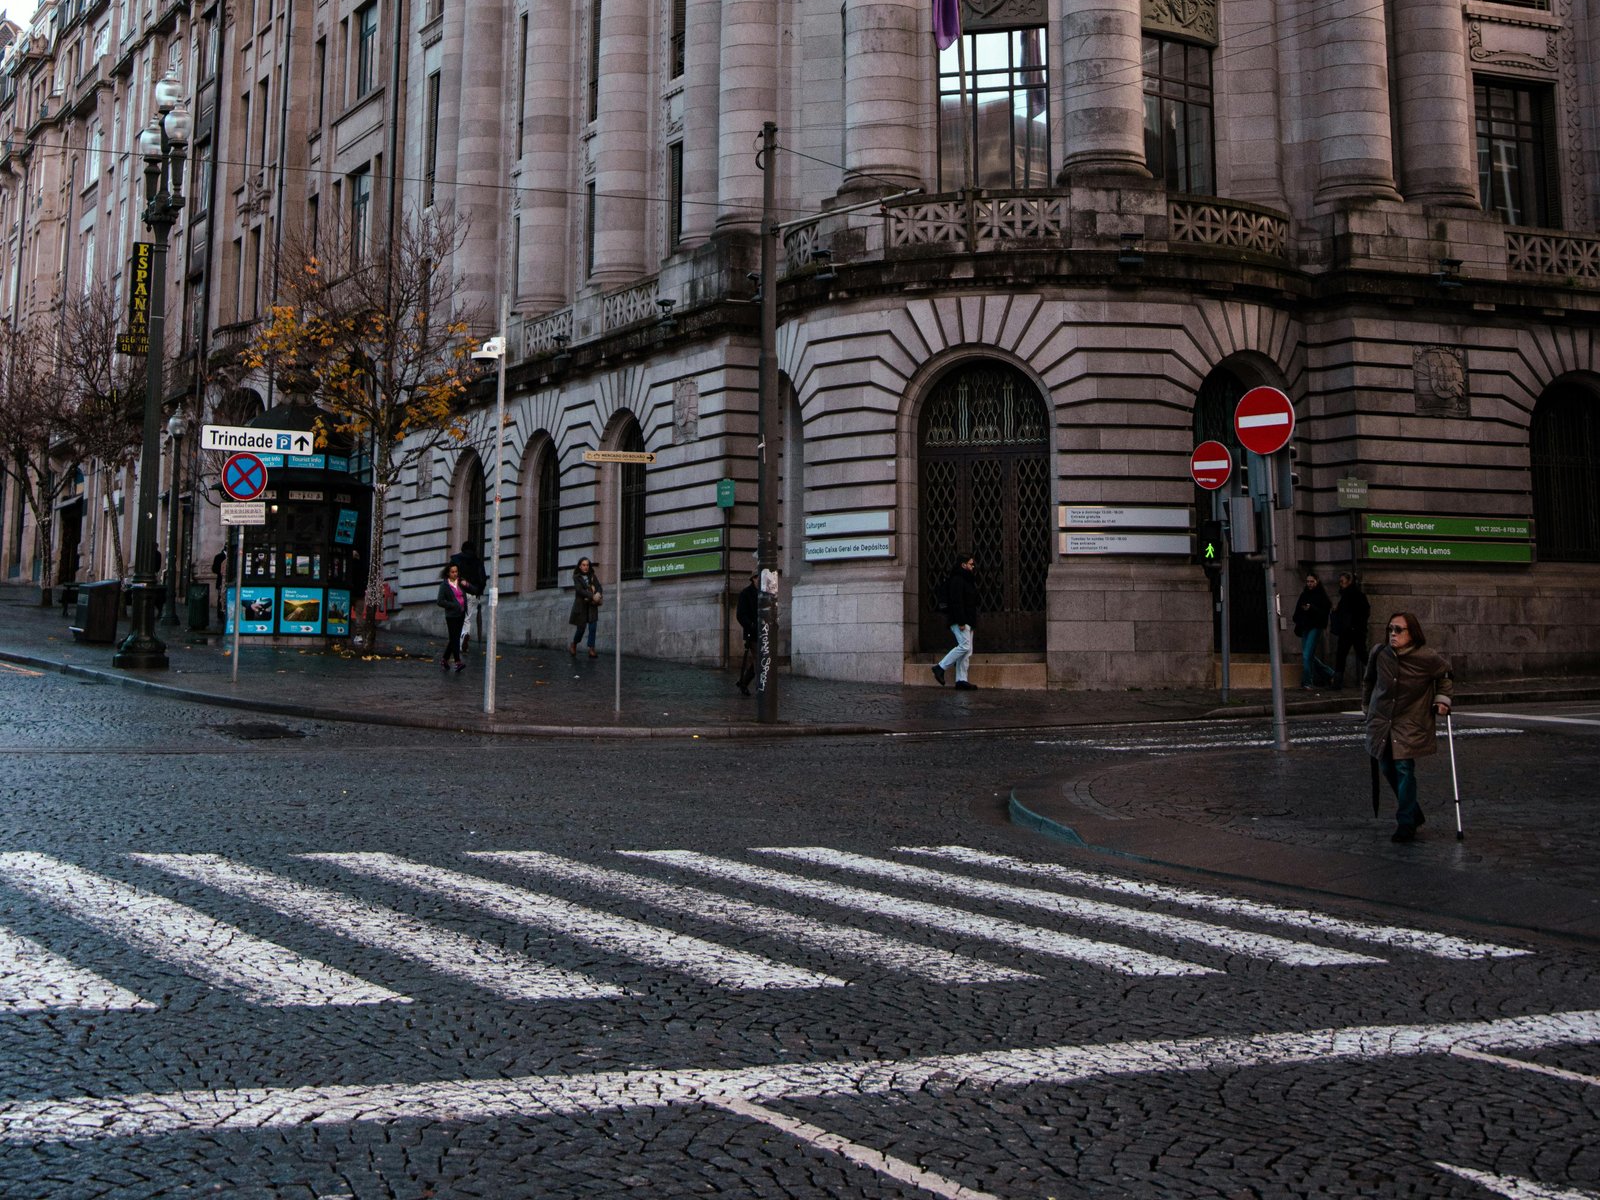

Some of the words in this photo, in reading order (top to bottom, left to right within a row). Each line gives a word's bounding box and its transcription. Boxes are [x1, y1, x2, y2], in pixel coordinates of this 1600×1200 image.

[210, 430, 273, 449] Trindade
[806, 521, 827, 531] Culturgest
[1371, 519, 1403, 529] Reluctant
[1404, 521, 1435, 531] Gardener
[806, 546, 825, 555] Fundação
[825, 546, 838, 554] Caixa
[838, 545, 852, 553] Geral
[853, 544, 860, 552] de
[861, 542, 889, 553] Depósitos
[1372, 544, 1399, 554] Curated
[1400, 545, 1410, 555] by
[1410, 546, 1428, 555] Sofia
[1429, 546, 1452, 555] Lemos
